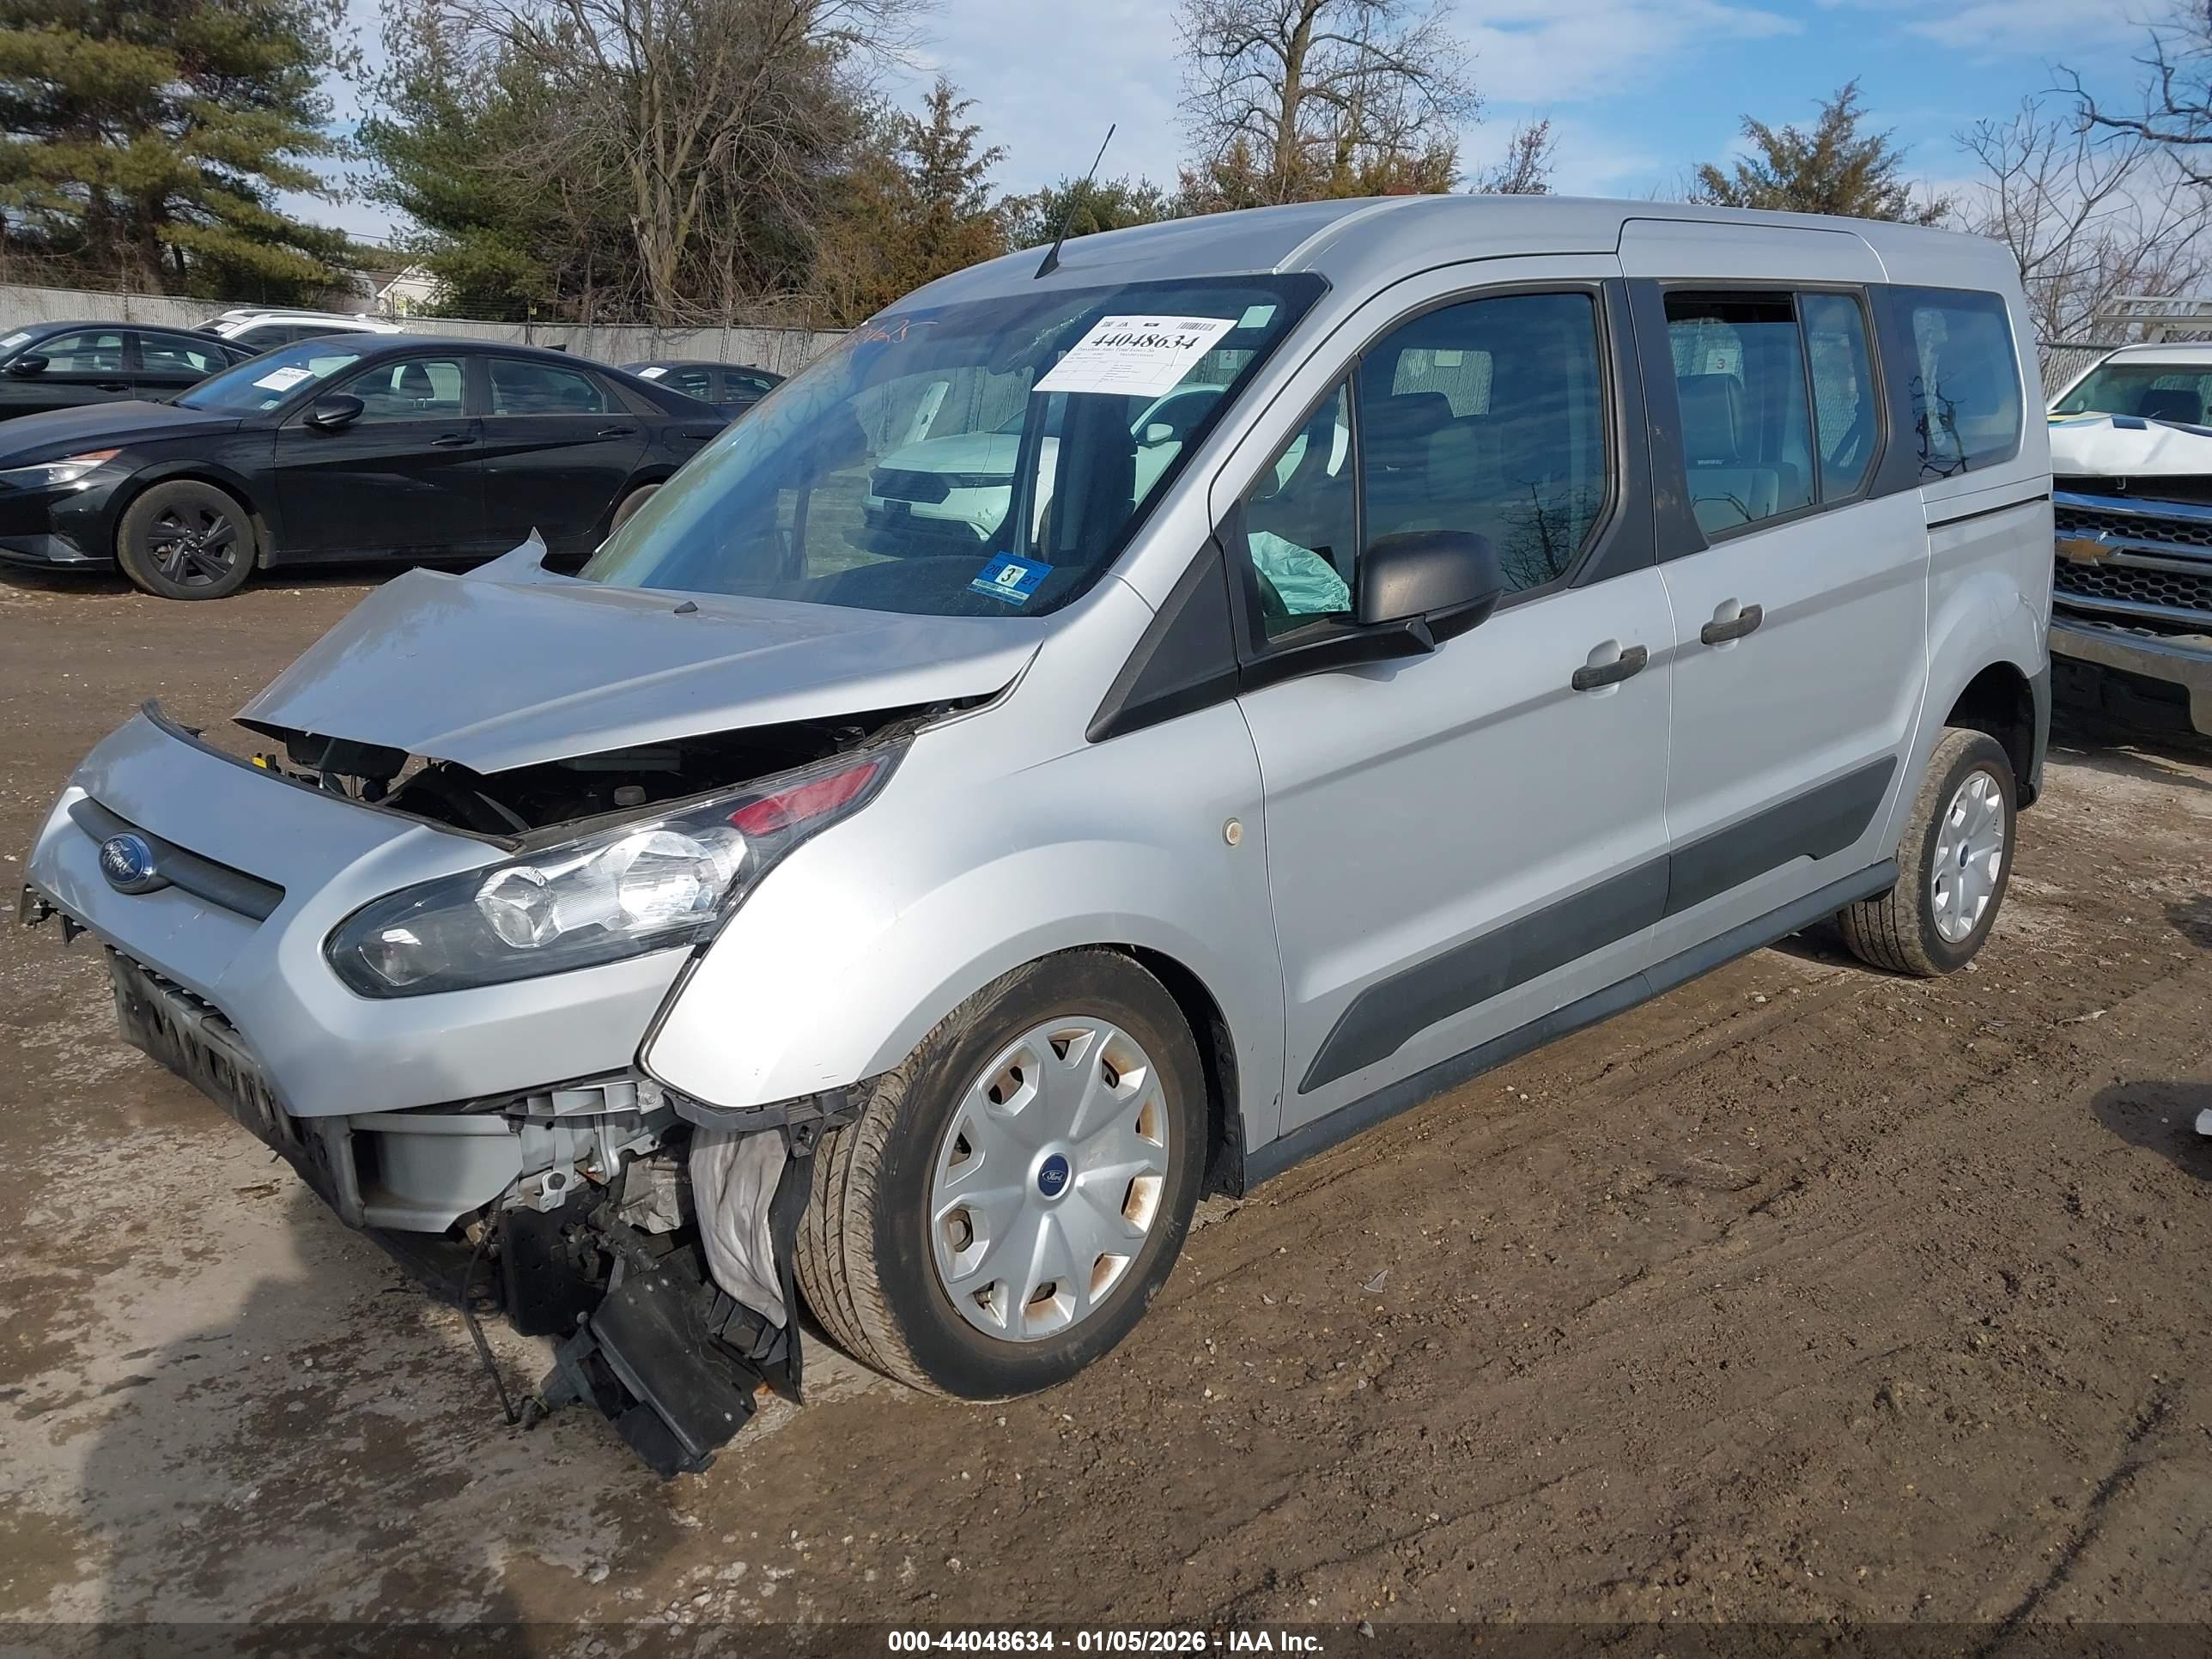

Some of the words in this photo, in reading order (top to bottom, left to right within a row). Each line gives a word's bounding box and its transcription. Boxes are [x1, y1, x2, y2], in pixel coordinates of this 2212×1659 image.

[1091, 332, 1200, 350] 44048634
[1717, 357, 1726, 370] 3
[1000, 568, 1016, 583] 3
[1020, 576, 1039, 586] 27
